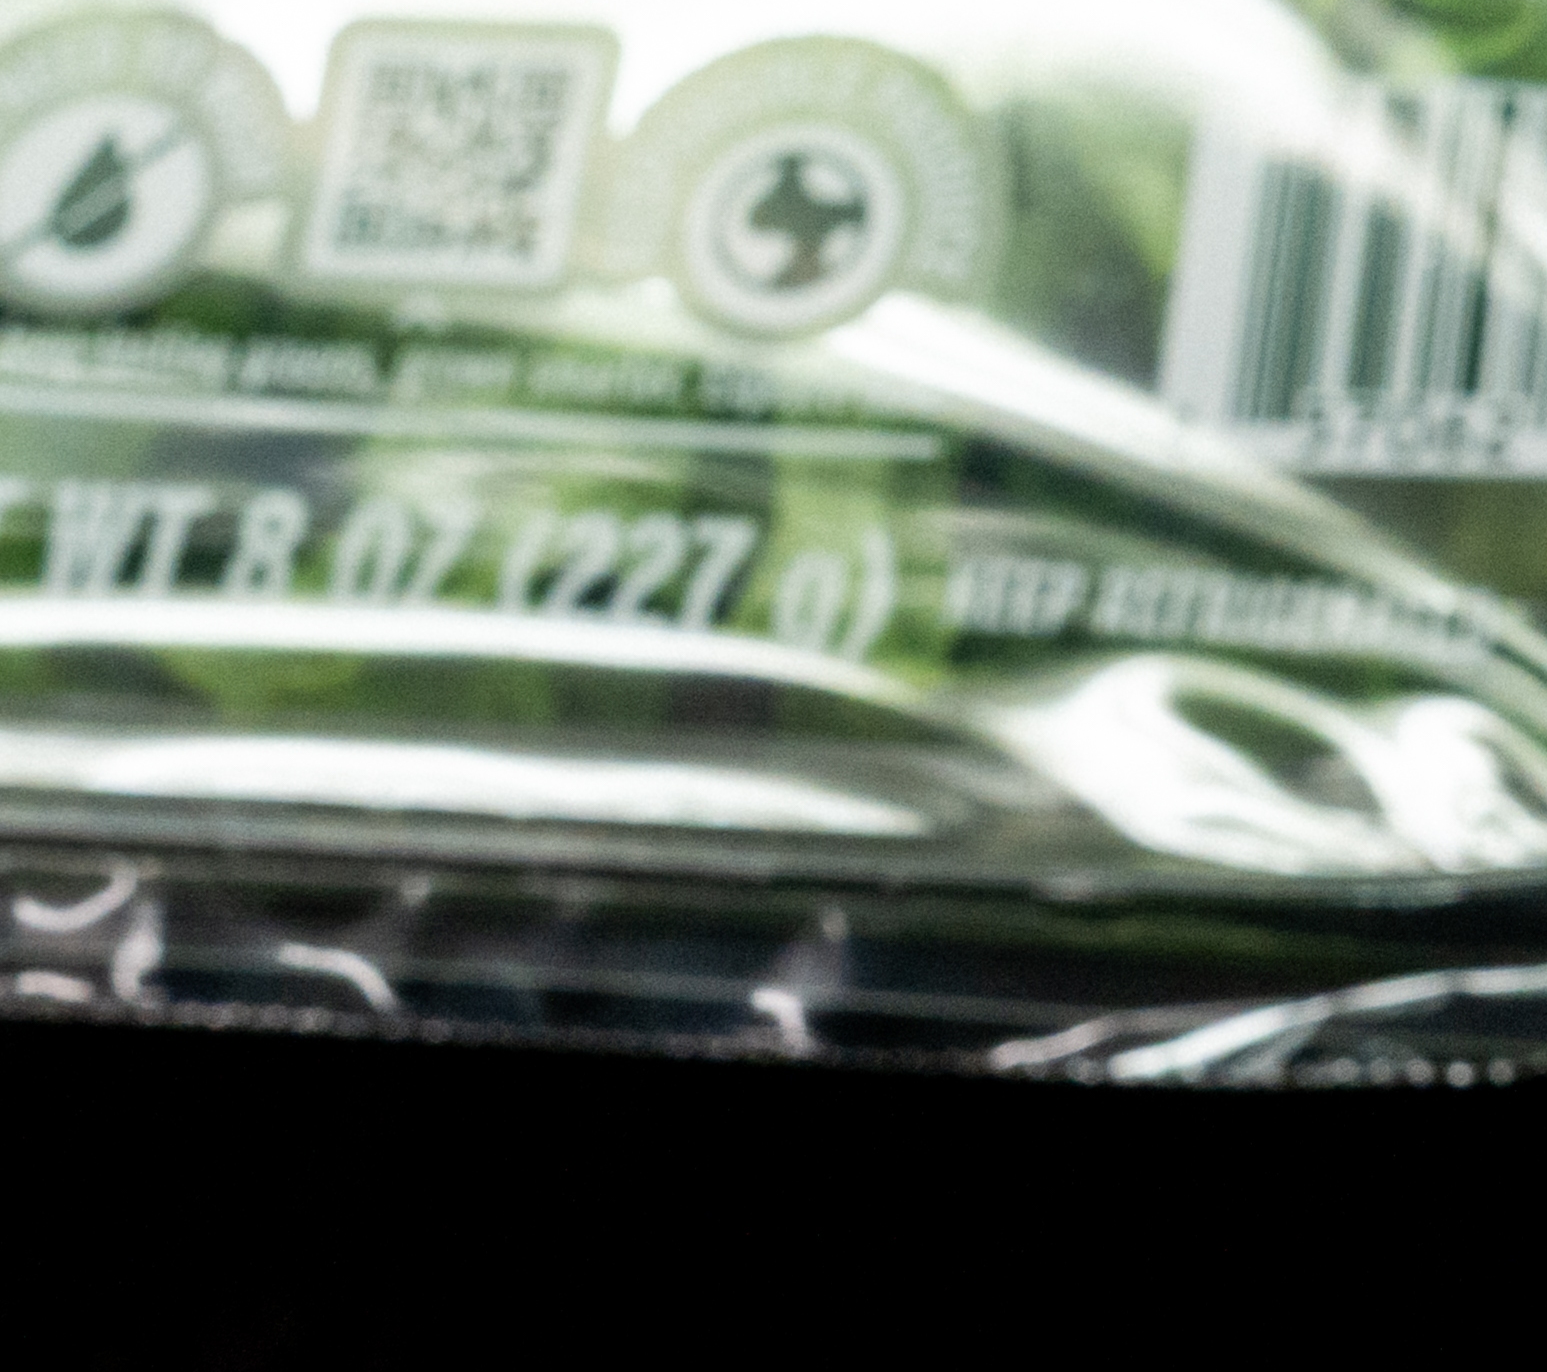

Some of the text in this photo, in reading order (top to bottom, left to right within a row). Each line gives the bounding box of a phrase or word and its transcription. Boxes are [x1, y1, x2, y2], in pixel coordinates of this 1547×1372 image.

[44, 479, 214, 597] WT
[220, 487, 311, 600] 8
[330, 494, 484, 604] OZ
[498, 508, 760, 627] (227
